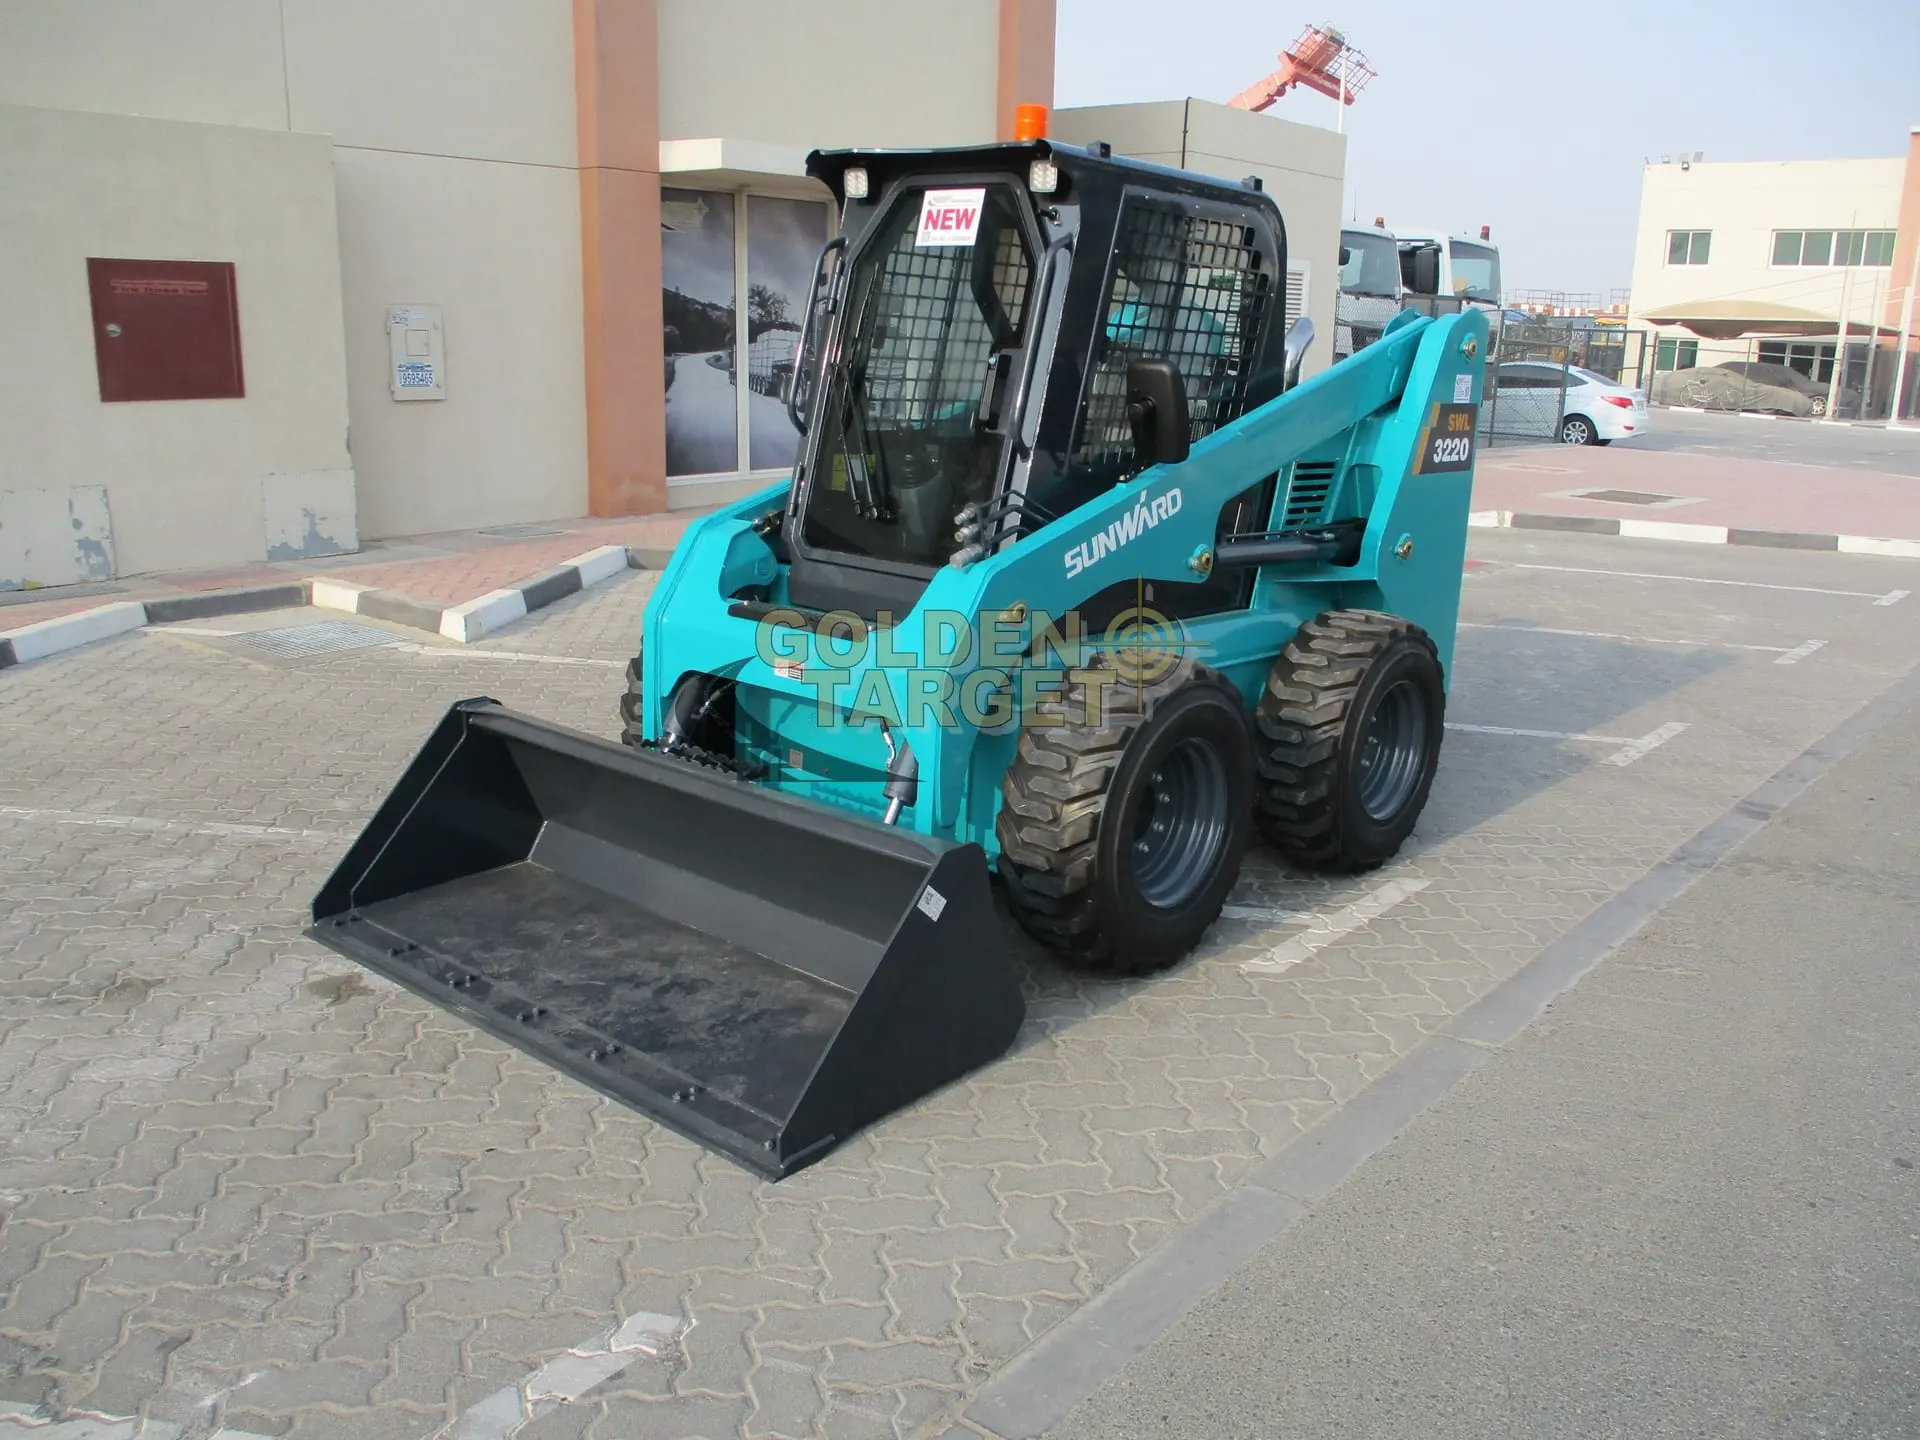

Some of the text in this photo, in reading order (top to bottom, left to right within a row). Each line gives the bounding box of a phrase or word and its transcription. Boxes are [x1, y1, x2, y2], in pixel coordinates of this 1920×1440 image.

[924, 208, 976, 230] NEW
[1448, 413, 1470, 431] SWL
[1433, 437, 1469, 463] 3220
[1064, 487, 1183, 580] SUNWARD
